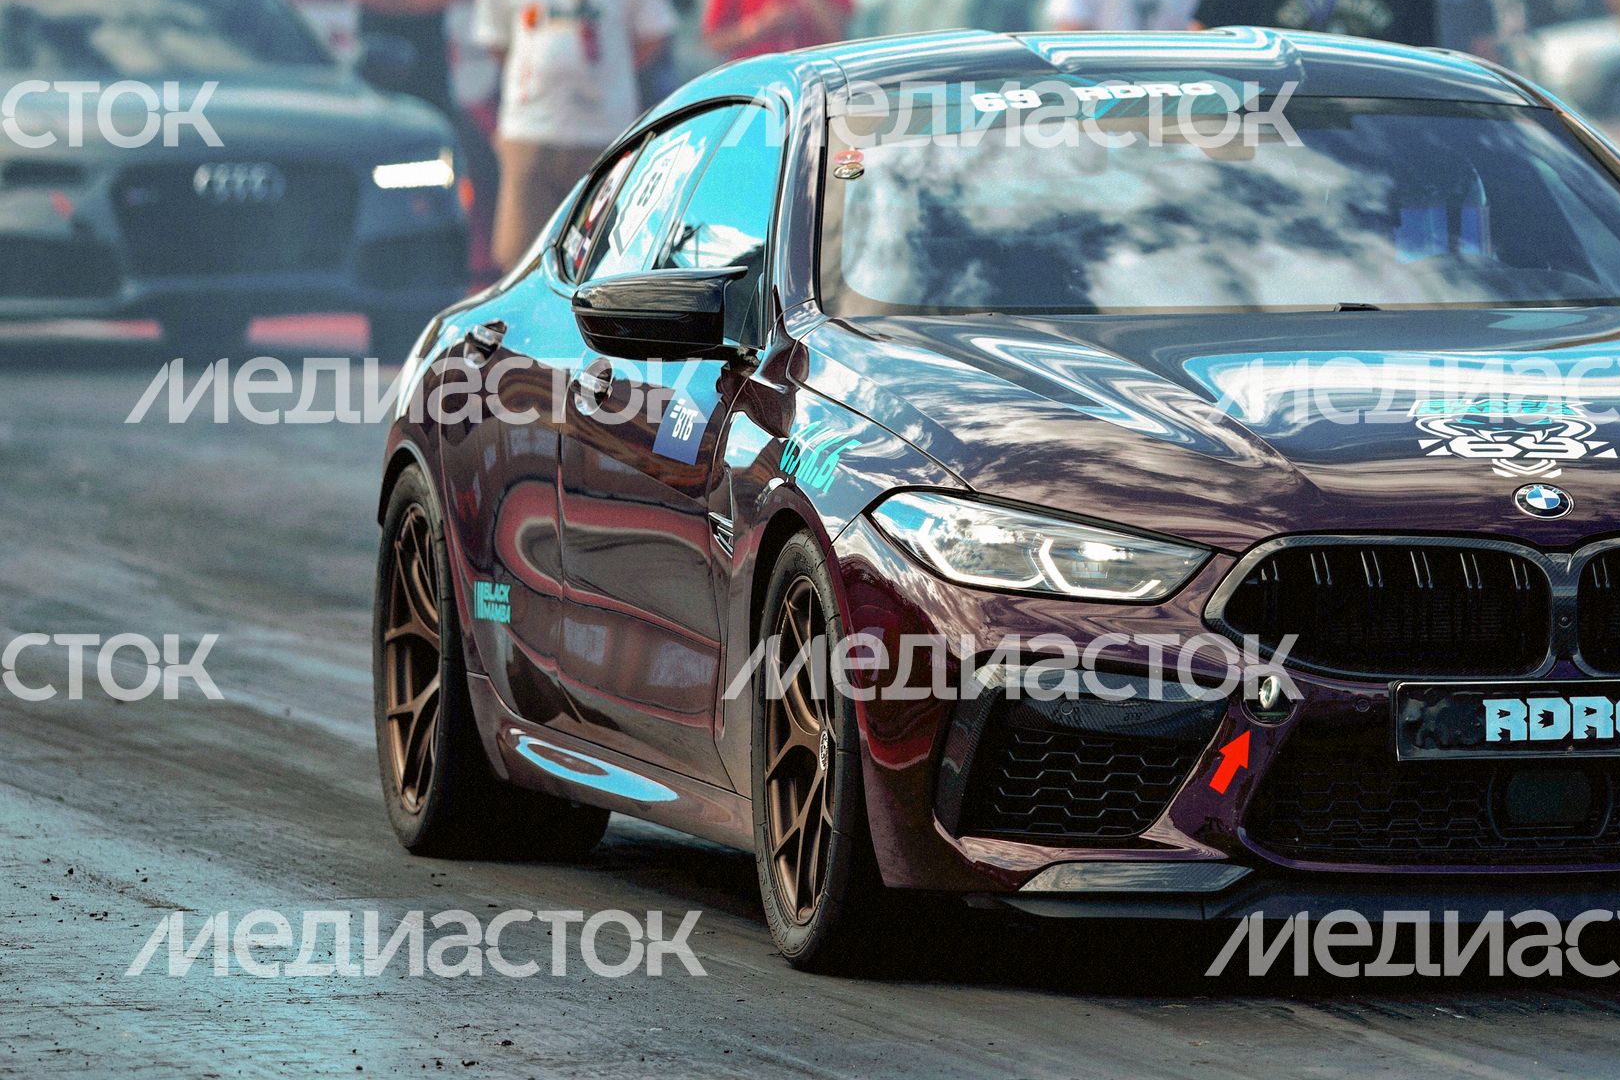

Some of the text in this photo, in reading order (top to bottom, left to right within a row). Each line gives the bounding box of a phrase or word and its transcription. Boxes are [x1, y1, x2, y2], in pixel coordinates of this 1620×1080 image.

[969, 88, 1043, 113] 69
[672, 407, 699, 441] ВТБ
[1449, 436, 1588, 459] 69
